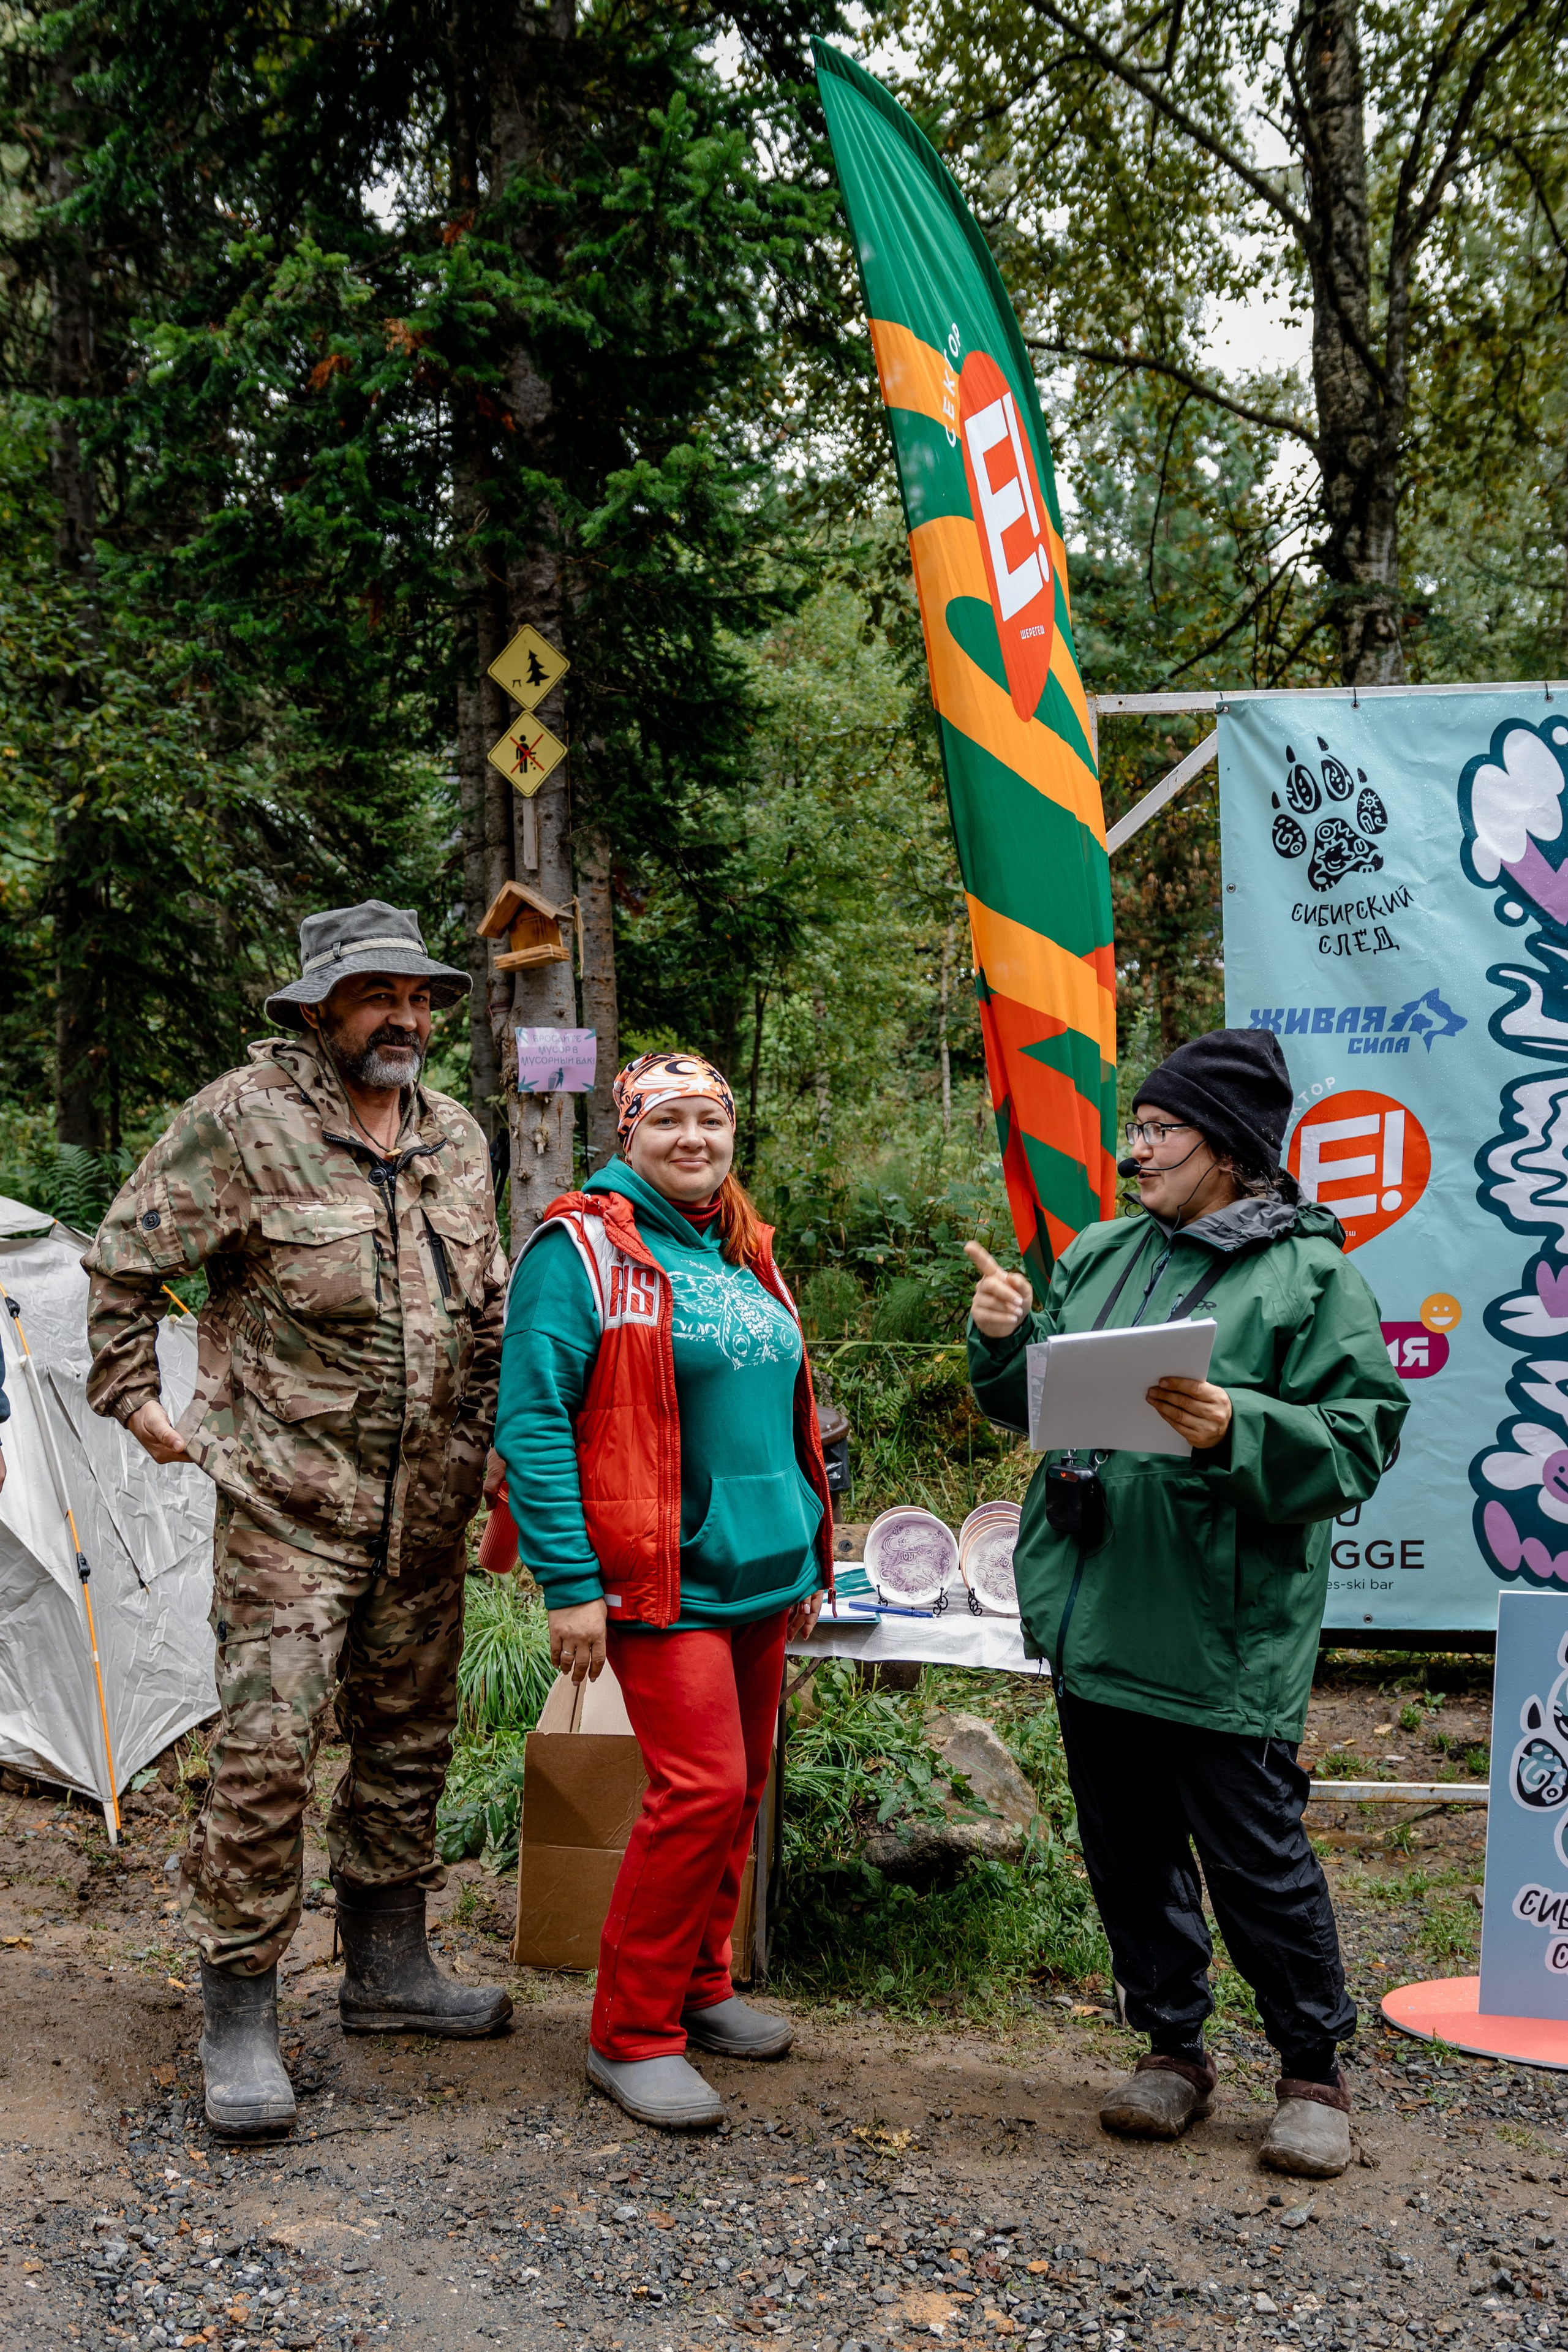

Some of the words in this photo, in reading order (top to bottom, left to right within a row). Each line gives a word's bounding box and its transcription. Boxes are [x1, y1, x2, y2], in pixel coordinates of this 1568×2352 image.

[942, 323, 961, 448] СЕКТОР
[1020, 625, 1045, 640] ШЕРЕГЕШ
[1291, 884, 1415, 927] СИБИРСКИЙ
[1248, 1006, 1387, 1035] ЖИВАЯ
[538, 1046, 571, 1055] МУСОР
[1348, 1036, 1411, 1055] СИЛА
[521, 1055, 574, 1066] МУСОРНЫЙ
[576, 1057, 595, 1065] БАК!
[1287, 1076, 1336, 1127] КТОР
[1370, 1578, 1395, 1590] bar
